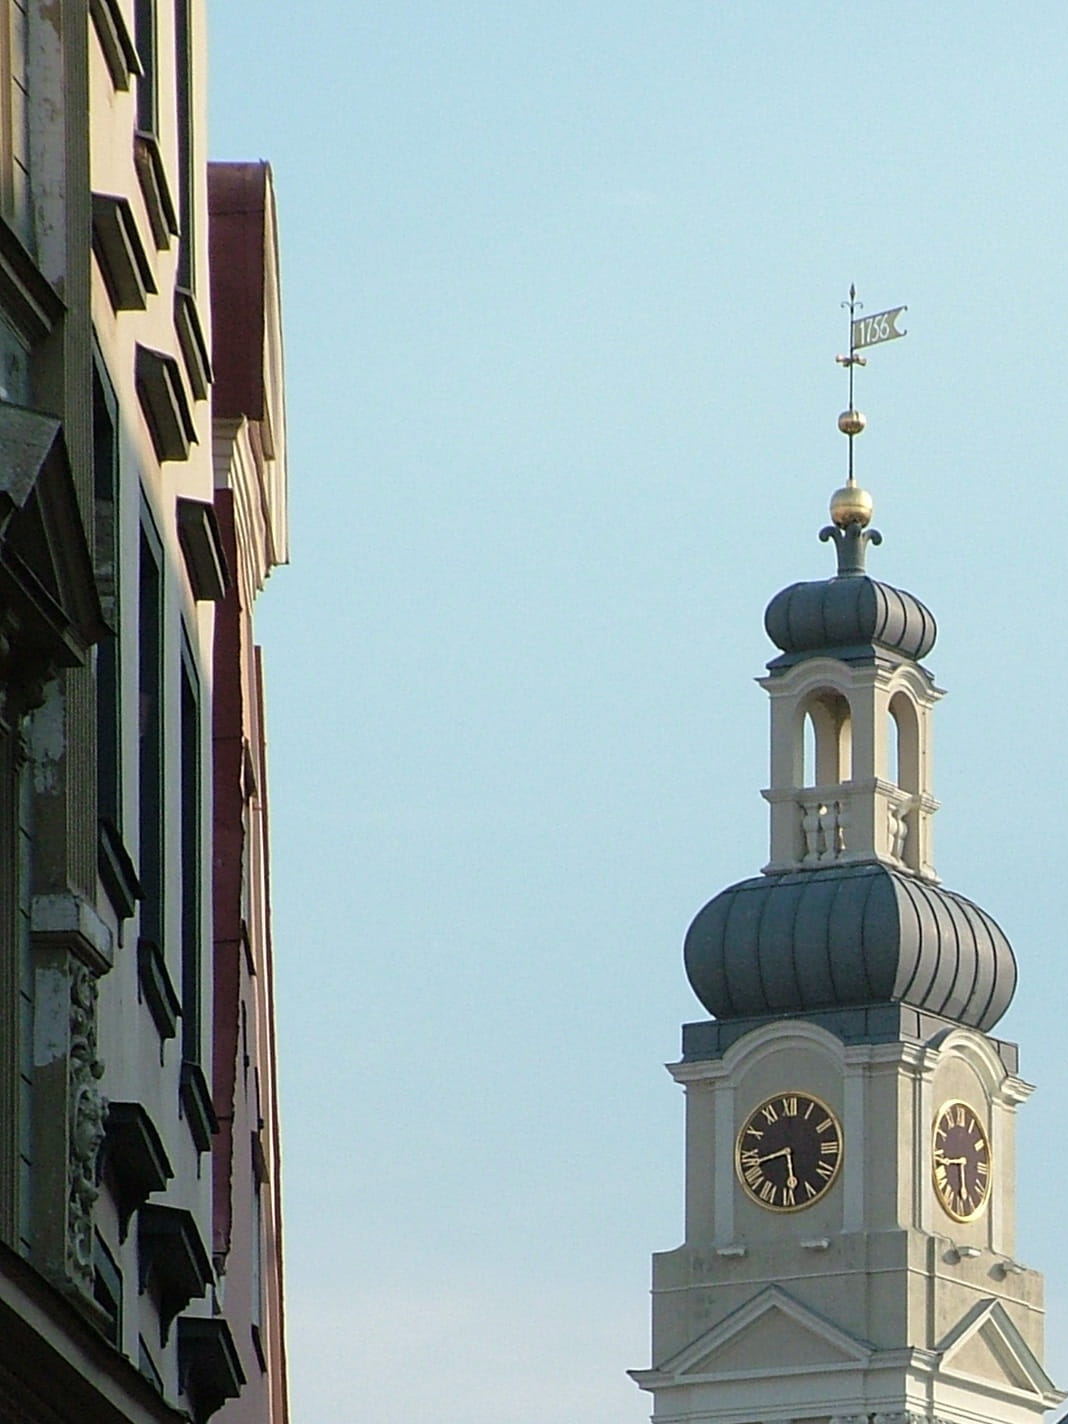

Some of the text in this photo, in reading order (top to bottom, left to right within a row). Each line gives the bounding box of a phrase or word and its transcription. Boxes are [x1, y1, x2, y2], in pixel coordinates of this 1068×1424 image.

[860, 314, 889, 345] 1756
[761, 1104, 779, 1125] XI
[782, 1097, 797, 1116] XII
[804, 1102, 814, 1119] I
[747, 1125, 764, 1140] X
[816, 1118, 832, 1134] II
[820, 1141, 838, 1154] III
[745, 1167, 764, 1190] VIII
[816, 1161, 834, 1180] IV
[759, 1180, 777, 1203] VII
[783, 1188, 795, 1206] VI
[804, 1181, 817, 1198] V
